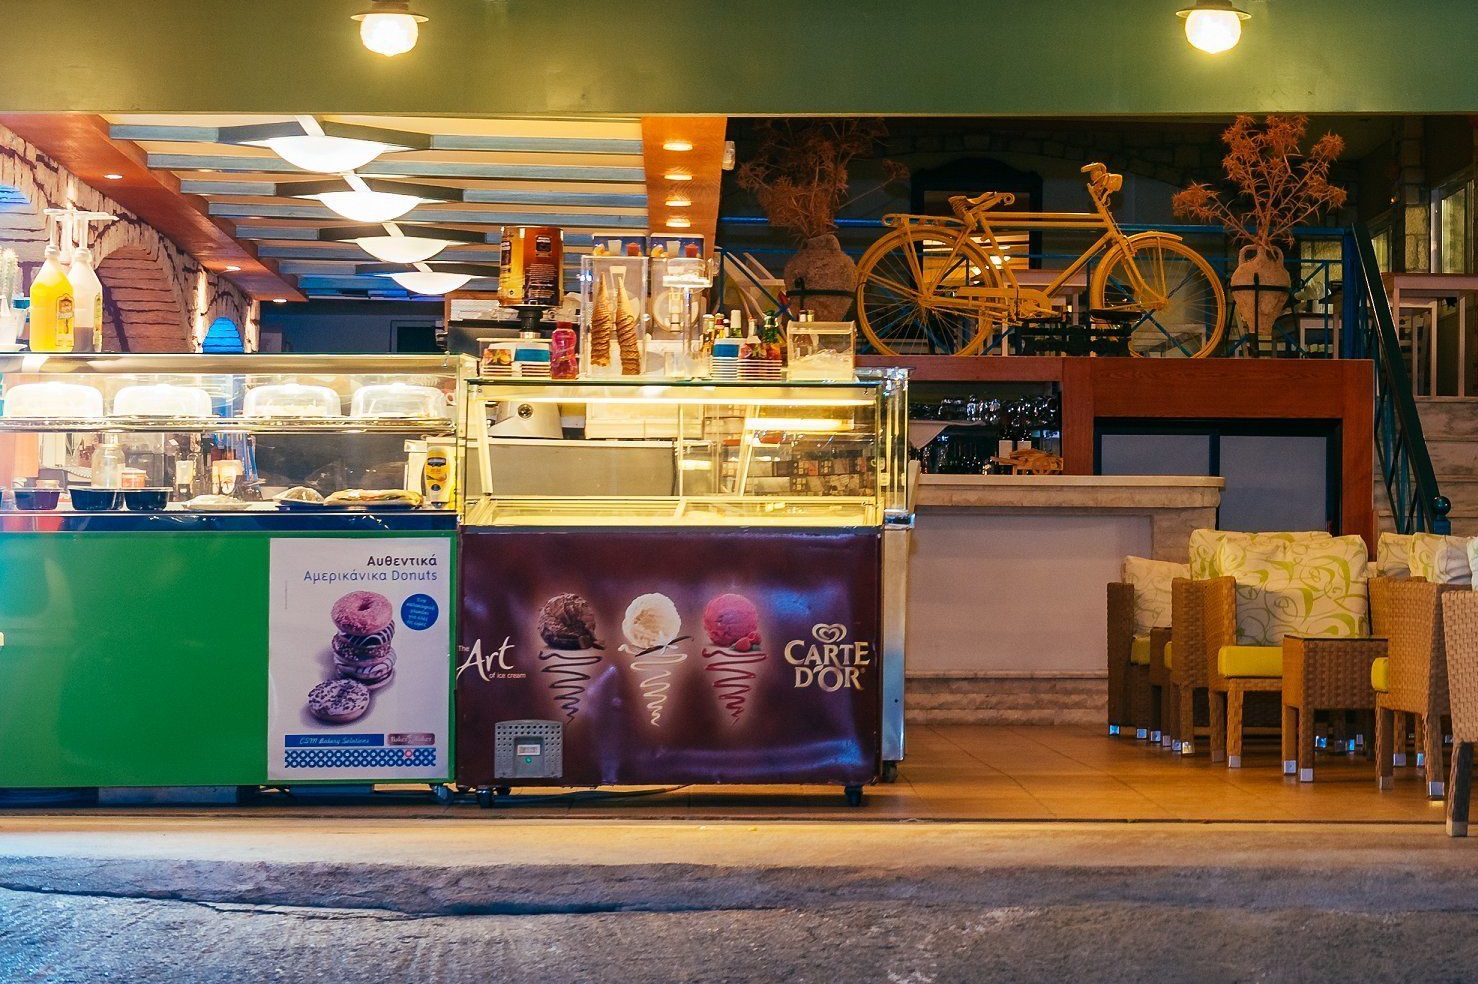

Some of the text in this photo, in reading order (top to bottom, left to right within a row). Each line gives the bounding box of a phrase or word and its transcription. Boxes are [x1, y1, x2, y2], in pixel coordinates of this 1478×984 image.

[366, 554, 438, 567] Αυθεντικά
[303, 569, 438, 584] Αμερικάνικα Donuts
[456, 636, 515, 682] Art
[784, 639, 871, 669] CARTE
